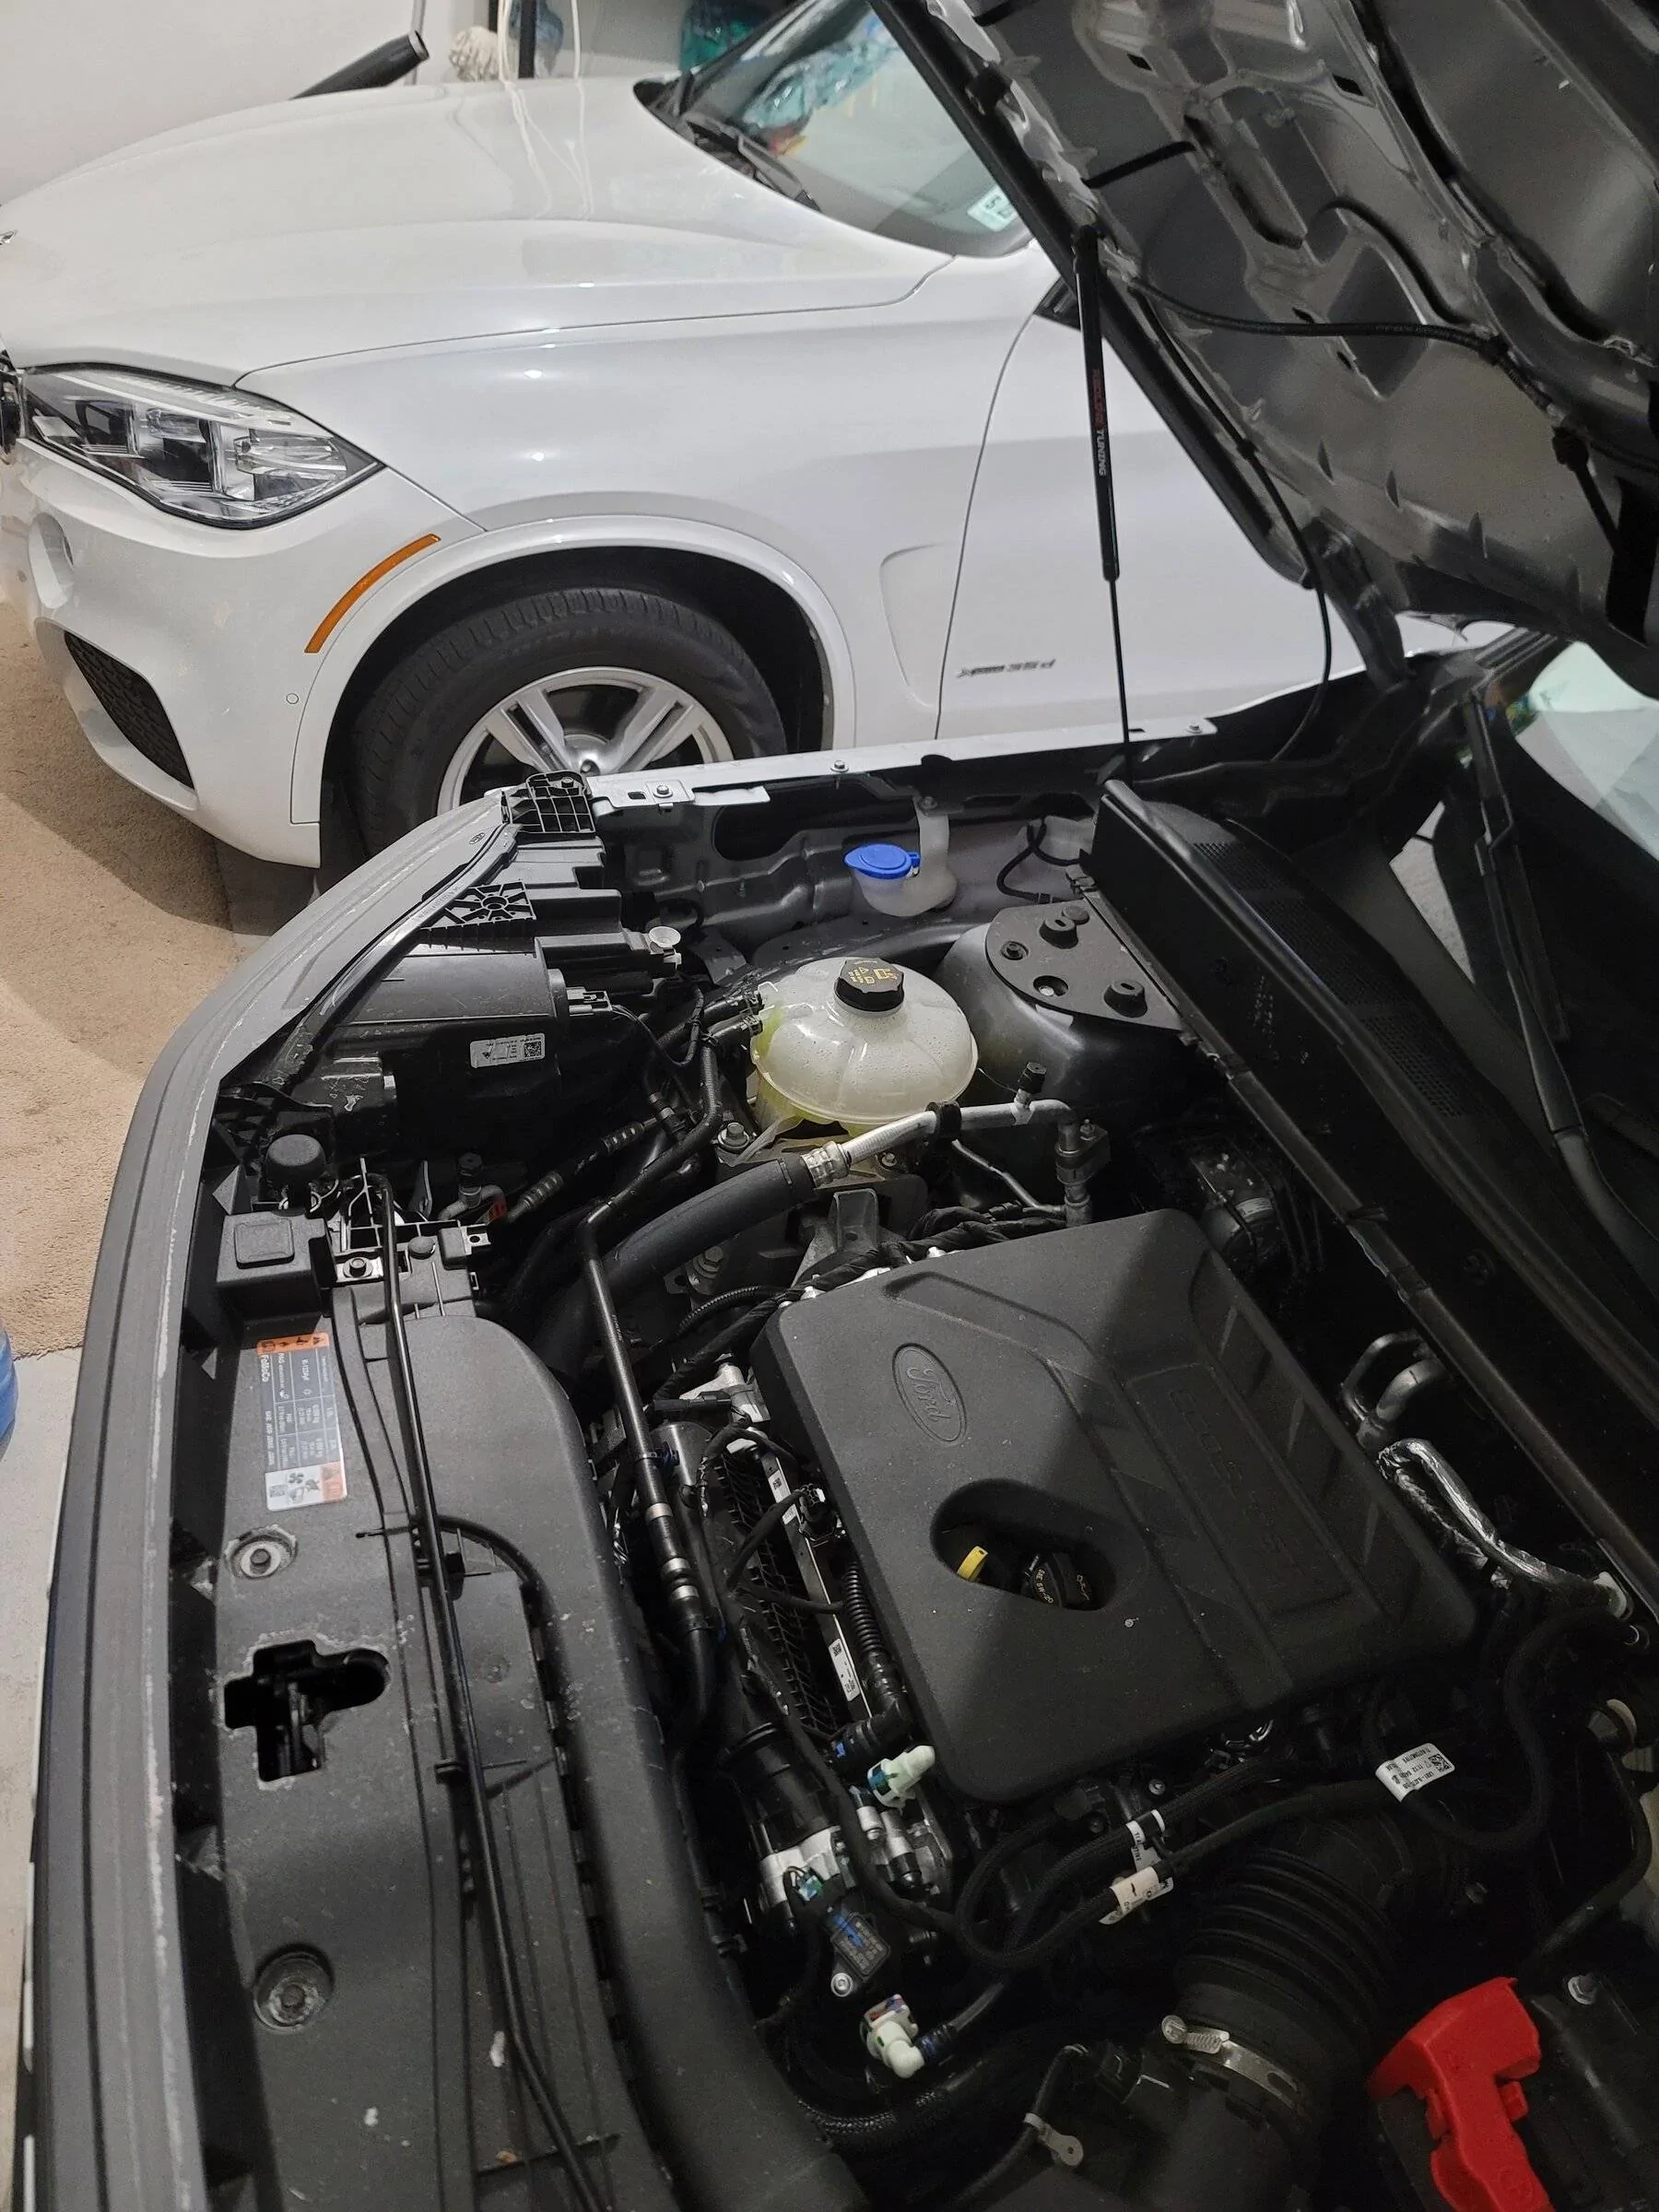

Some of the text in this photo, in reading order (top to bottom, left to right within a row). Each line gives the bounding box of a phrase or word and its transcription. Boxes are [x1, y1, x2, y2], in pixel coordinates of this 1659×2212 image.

[1097, 429, 1107, 476] TUNING
[260, 1354, 269, 1382] FoMoCo
[906, 1367, 956, 1422] Ford
